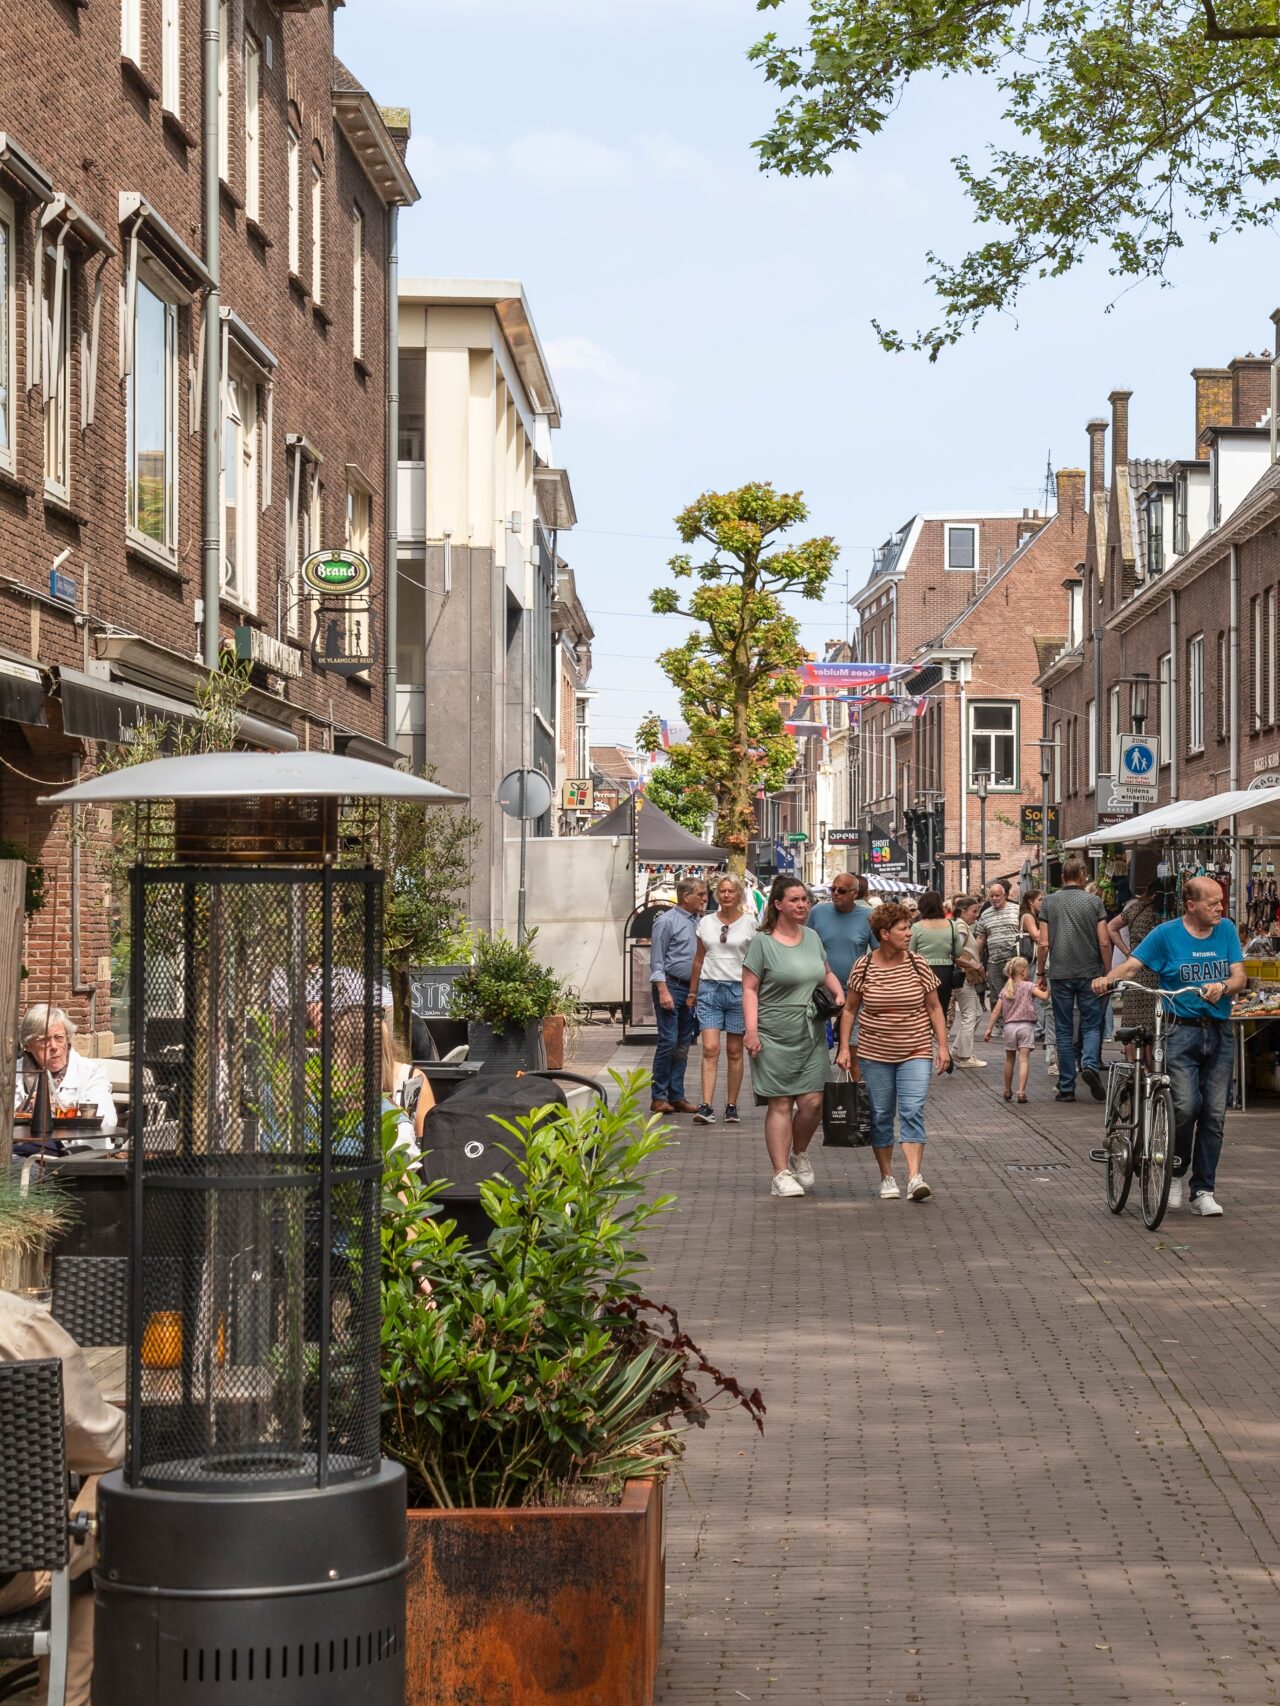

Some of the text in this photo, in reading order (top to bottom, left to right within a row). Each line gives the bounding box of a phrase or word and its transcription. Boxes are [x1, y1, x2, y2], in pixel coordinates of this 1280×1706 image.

[317, 563, 356, 578] Brand
[1121, 794, 1154, 802] winkeltijd
[871, 839, 890, 848] SHOOT
[872, 846, 891, 863] 99
[410, 981, 456, 1010] STR
